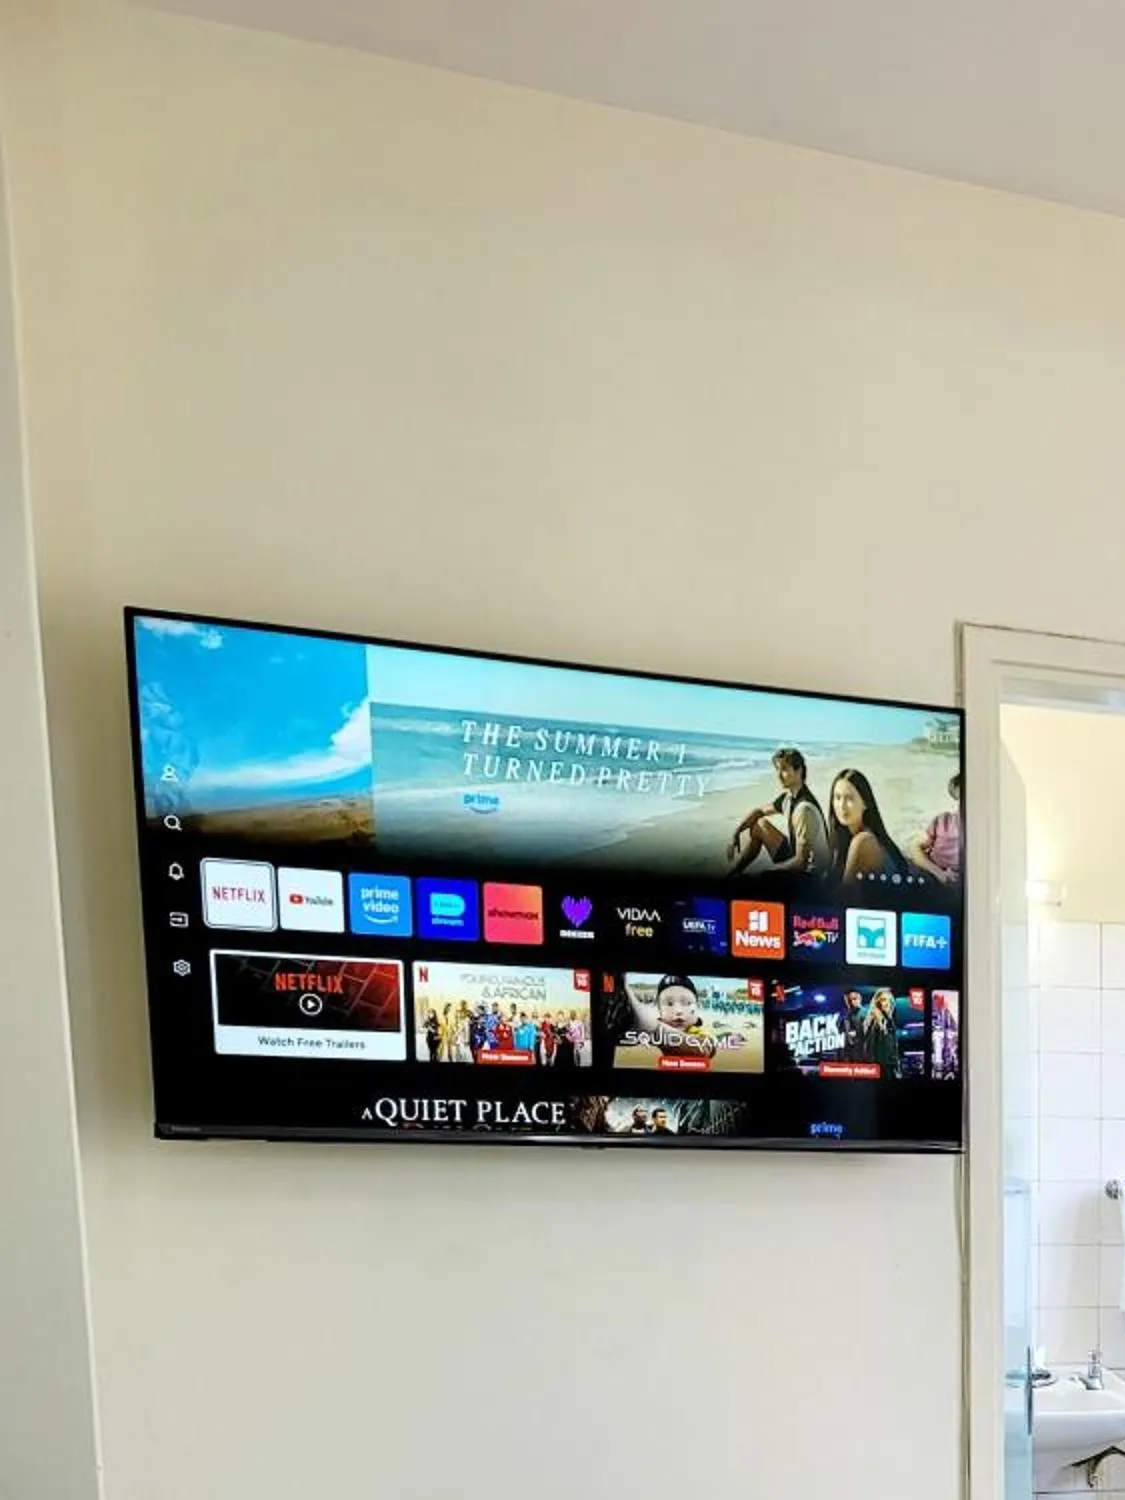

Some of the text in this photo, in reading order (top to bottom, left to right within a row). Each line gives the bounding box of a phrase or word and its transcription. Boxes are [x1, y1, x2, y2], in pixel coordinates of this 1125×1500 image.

[461, 720, 522, 748] THE
[534, 727, 661, 762] SUMMER
[463, 752, 711, 798] TURNED PRETTY
[463, 792, 500, 807] prime
[212, 885, 266, 903] NETFLIX
[360, 886, 400, 901] prime
[362, 900, 400, 914] video
[616, 907, 662, 922] VIDAA
[625, 922, 655, 937] free
[735, 929, 781, 949] News
[903, 933, 949, 951] FIFA+
[274, 972, 345, 994] NETFLIX
[491, 986, 548, 1001] AFRICAN
[785, 1012, 841, 1045] BACK
[257, 1035, 367, 1050] Watch Free Trailers
[620, 1027, 749, 1053] SQUID GAME
[794, 1032, 846, 1057] ACTION
[374, 1097, 468, 1127] QUIET
[476, 1100, 566, 1125] PLACE
